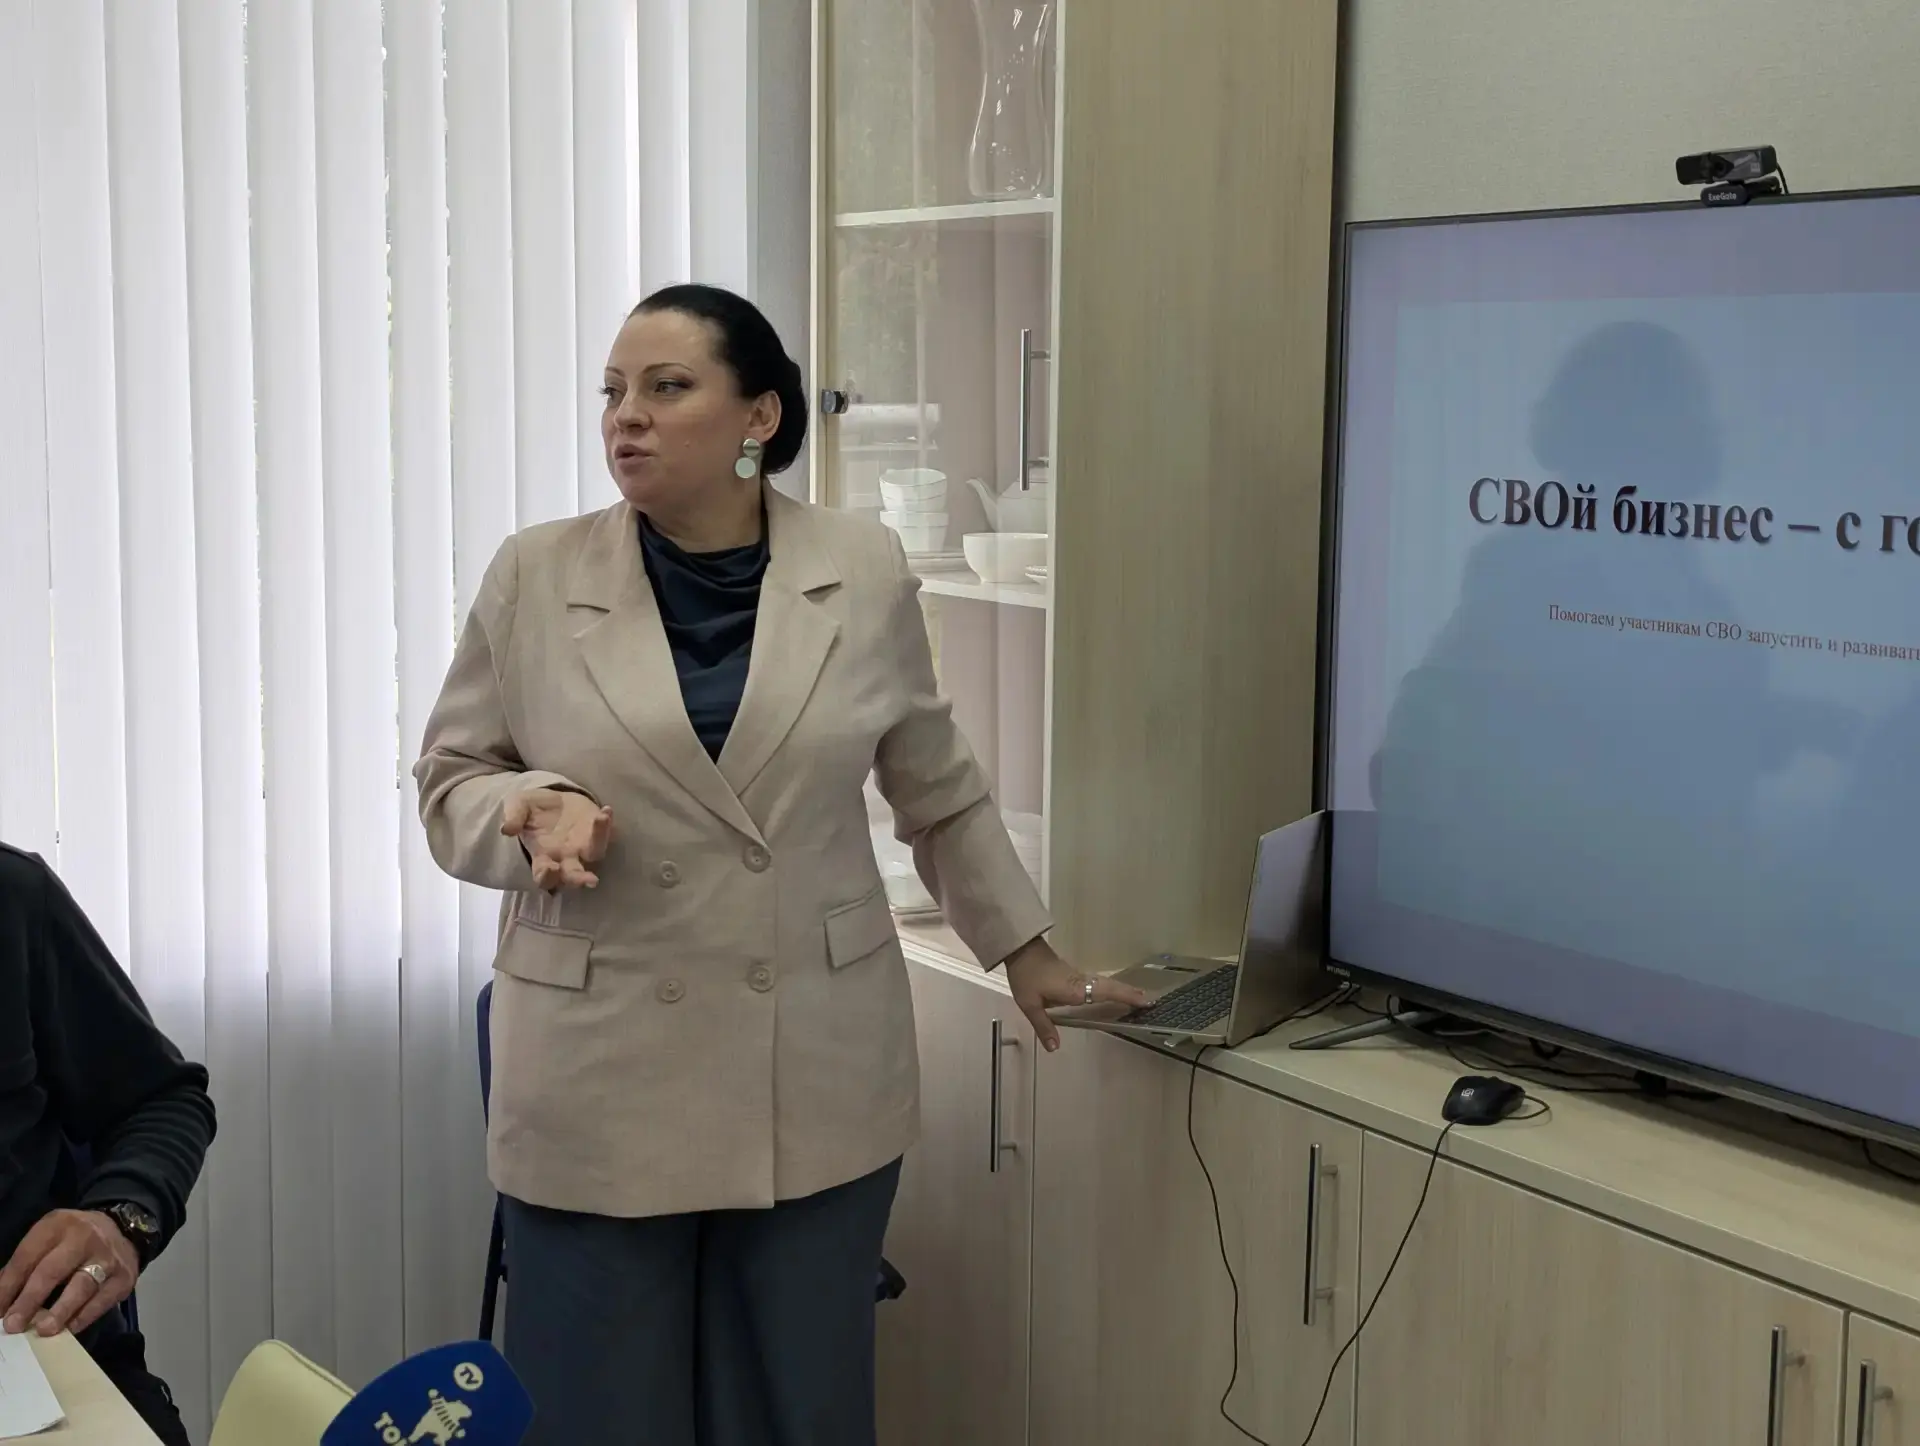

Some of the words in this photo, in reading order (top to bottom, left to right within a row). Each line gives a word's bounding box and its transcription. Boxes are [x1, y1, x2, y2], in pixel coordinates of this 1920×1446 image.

[1708, 192, 1737, 201] ExeGate
[1470, 477, 1598, 531] СВОй
[1613, 485, 1774, 543] бизнес
[1836, 512, 1861, 550] с
[1548, 604, 1615, 627] Помогаем
[1618, 616, 1701, 637] участникам
[1705, 621, 1742, 640] СВО
[1747, 629, 1823, 650] запустить
[1828, 638, 1838, 651] и
